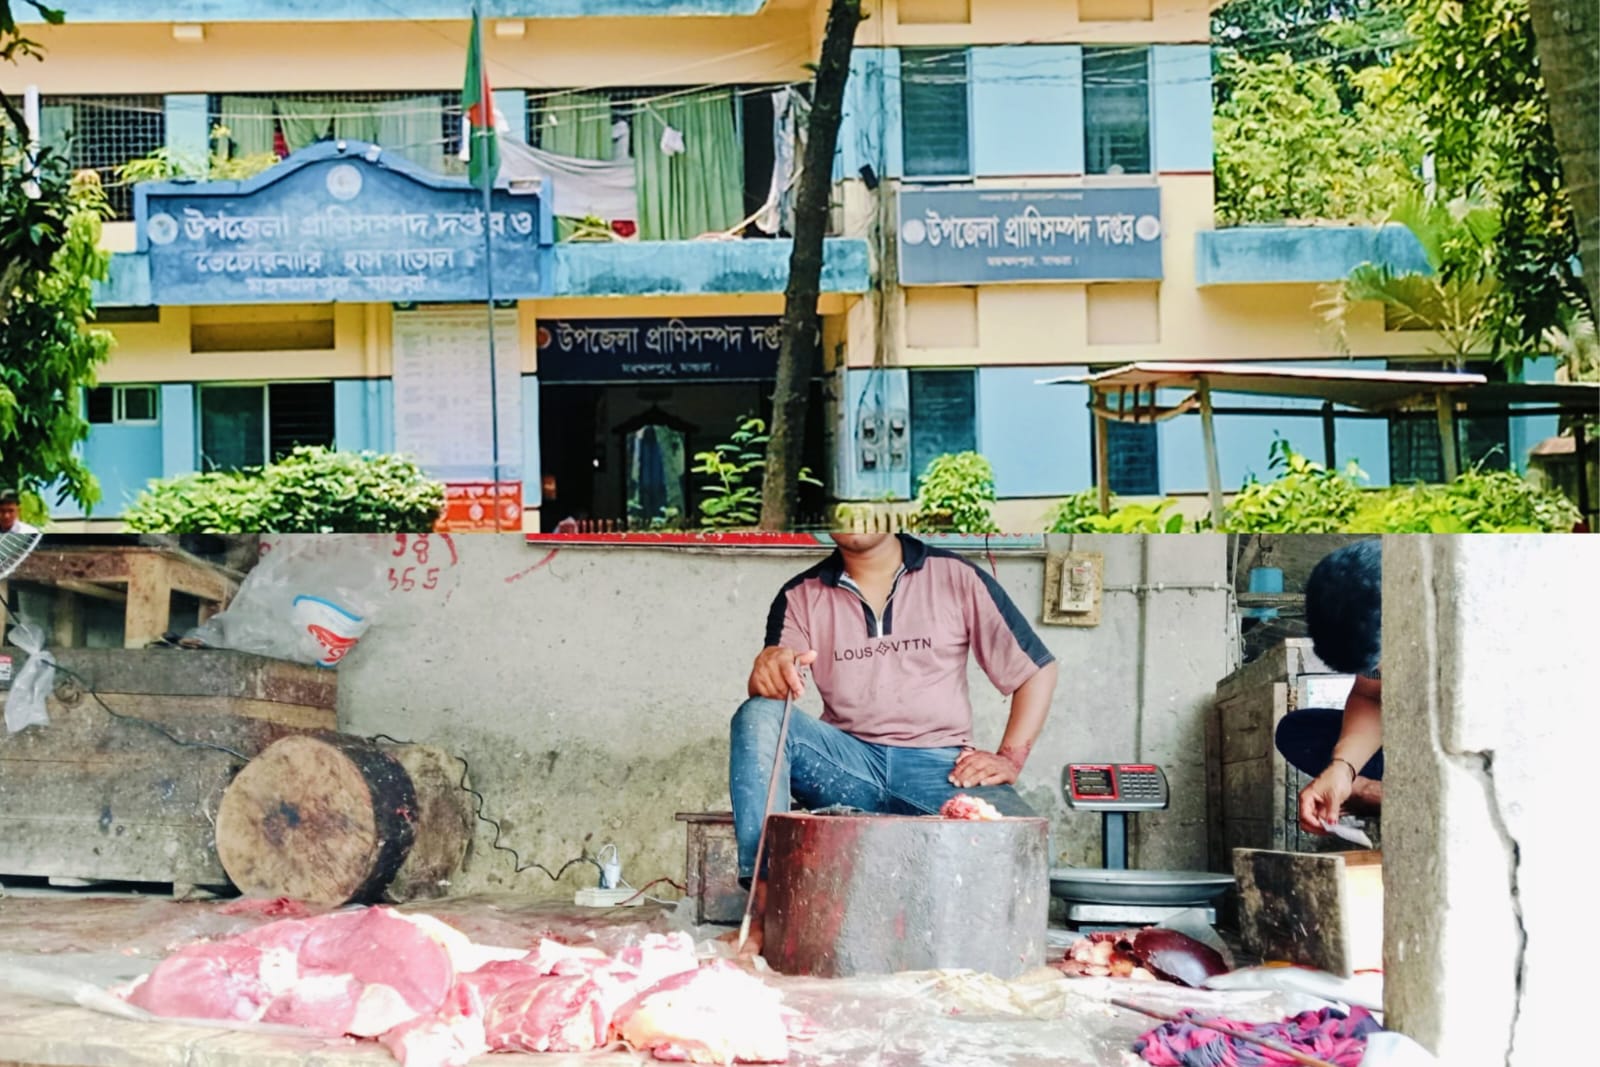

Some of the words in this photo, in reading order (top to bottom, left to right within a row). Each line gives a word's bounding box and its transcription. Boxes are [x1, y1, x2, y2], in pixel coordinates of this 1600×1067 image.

[183, 207, 290, 241] উপজেলা
[300, 204, 429, 242] প্রাণিসম্পদ
[434, 207, 506, 237] দপ্তর
[510, 210, 533, 235] ও
[925, 208, 999, 249] উপজেলা
[1003, 205, 1092, 249] প্রাণিসম্পদ
[1095, 212, 1136, 247] দপ্তর
[557, 321, 639, 354] উপজেলা
[645, 318, 744, 353] প্রাণিসম্পদ
[749, 324, 784, 352] দপ্ত
[834, 647, 873, 662] LOUS
[890, 637, 932, 653] VTTN
